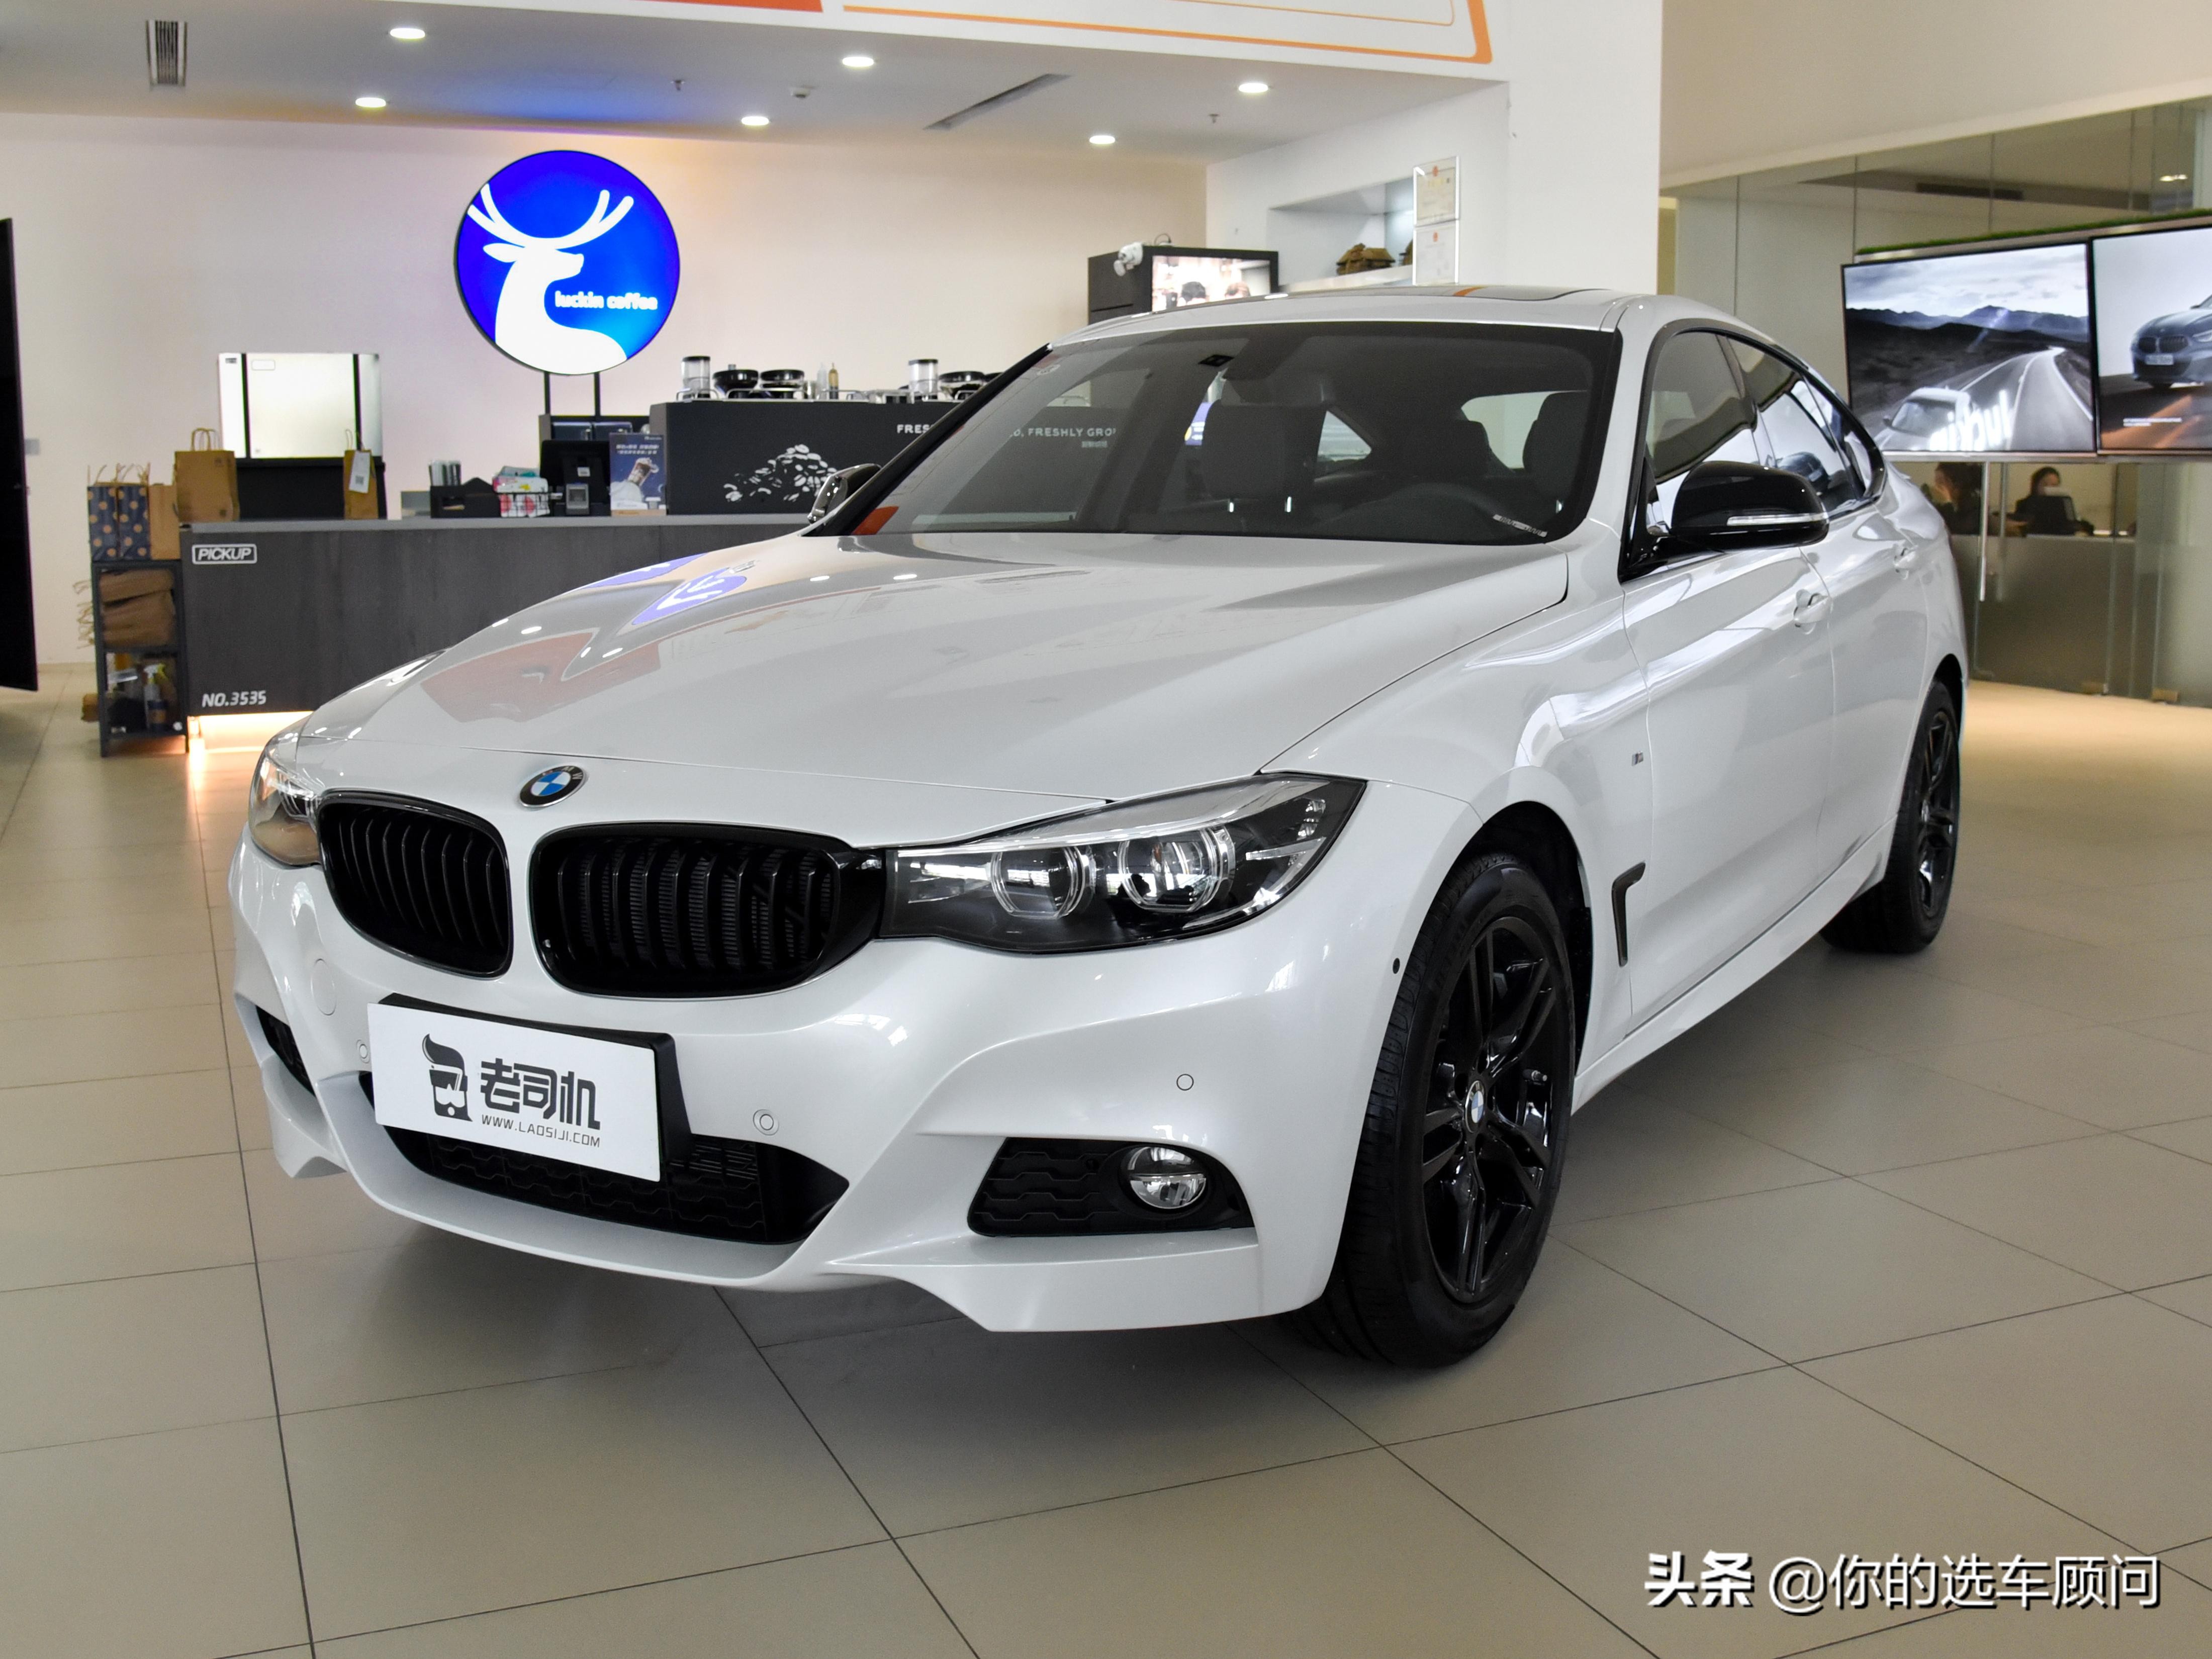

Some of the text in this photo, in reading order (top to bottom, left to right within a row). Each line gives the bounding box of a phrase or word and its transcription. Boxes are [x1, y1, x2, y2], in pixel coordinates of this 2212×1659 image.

[555, 291, 658, 310] luckin coffee
[897, 424, 934, 433] FRES
[1028, 428, 1083, 436] FRESHLY
[198, 547, 251, 561] PICKUP
[202, 690, 266, 707] NO.3535
[480, 1058, 601, 1131] 老司机
[481, 1114, 600, 1148] WWW.LAOSIJI.COM
